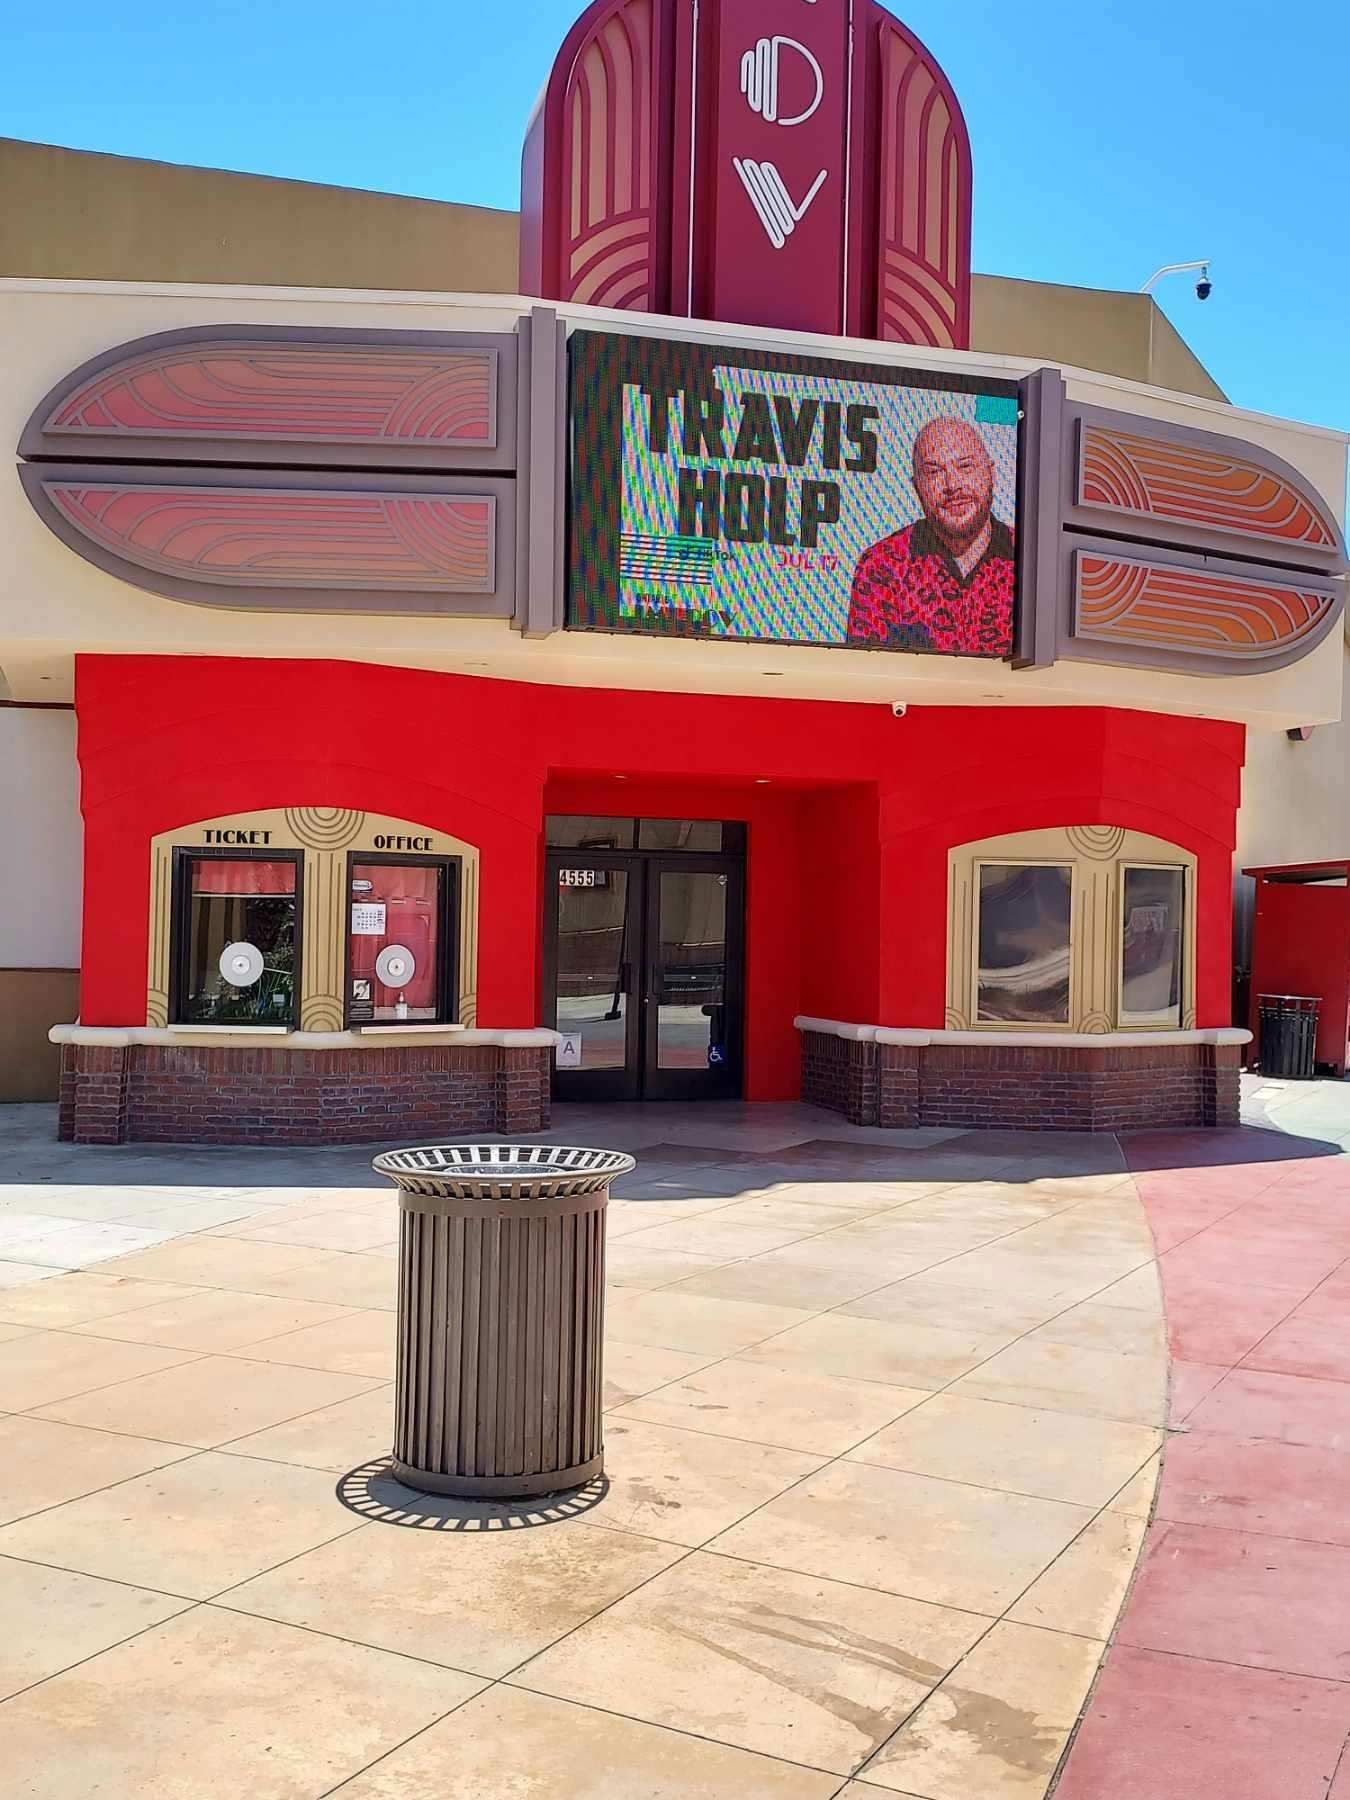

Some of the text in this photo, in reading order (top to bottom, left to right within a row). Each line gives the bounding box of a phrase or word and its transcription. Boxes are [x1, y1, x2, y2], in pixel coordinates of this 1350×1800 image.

[640, 376, 880, 473] TRAVIS
[678, 467, 840, 548] HOLP
[777, 551, 838, 571] JUL 17
[202, 829, 273, 844] TICKET
[374, 834, 433, 851] OFFICE
[560, 870, 593, 885] 4555
[563, 1040, 575, 1054] A
